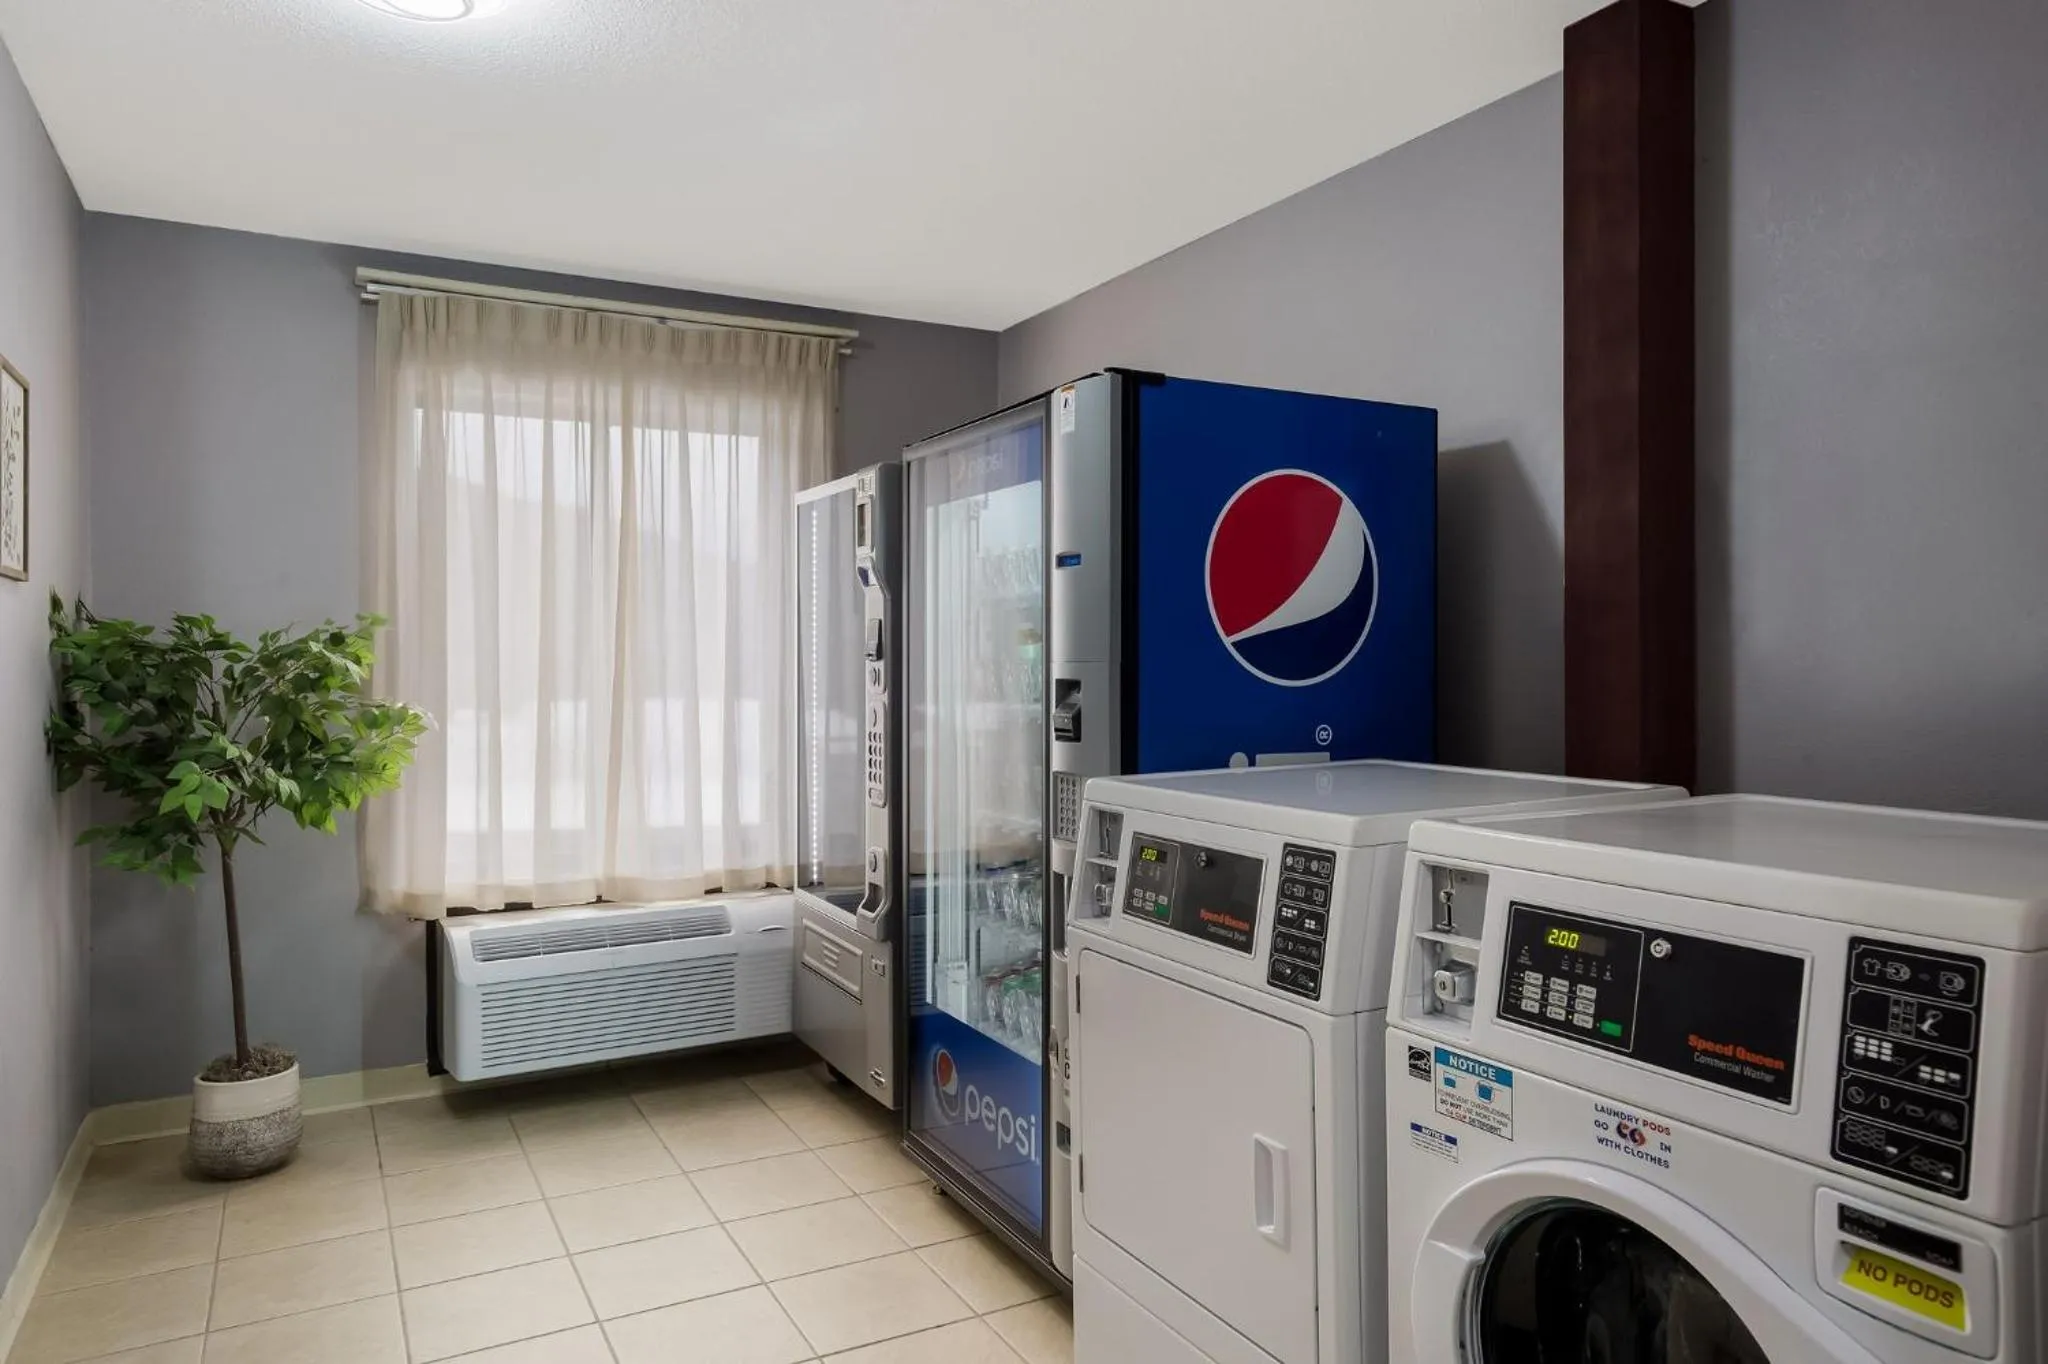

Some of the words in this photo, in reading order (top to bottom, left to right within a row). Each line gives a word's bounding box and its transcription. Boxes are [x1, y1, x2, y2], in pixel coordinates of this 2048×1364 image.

[1449, 1054, 1496, 1080] NOTICE
[1688, 1034, 1733, 1057] Speed
[1736, 1046, 1785, 1071] Queen
[1694, 1052, 1741, 1074] Commercial
[1743, 1065, 1775, 1083] Washer
[965, 1085, 1036, 1161] pepsi
[1594, 1103, 1639, 1124] LAUNDRY
[1642, 1119, 1671, 1136] PODS
[1594, 1120, 1608, 1130] GO
[1660, 1142, 1671, 1153] IN
[1597, 1136, 1621, 1150] WITH
[1624, 1145, 1669, 1169] CLOTHES
[1857, 1260, 1887, 1282] NO
[1893, 1273, 1955, 1308] PODS
